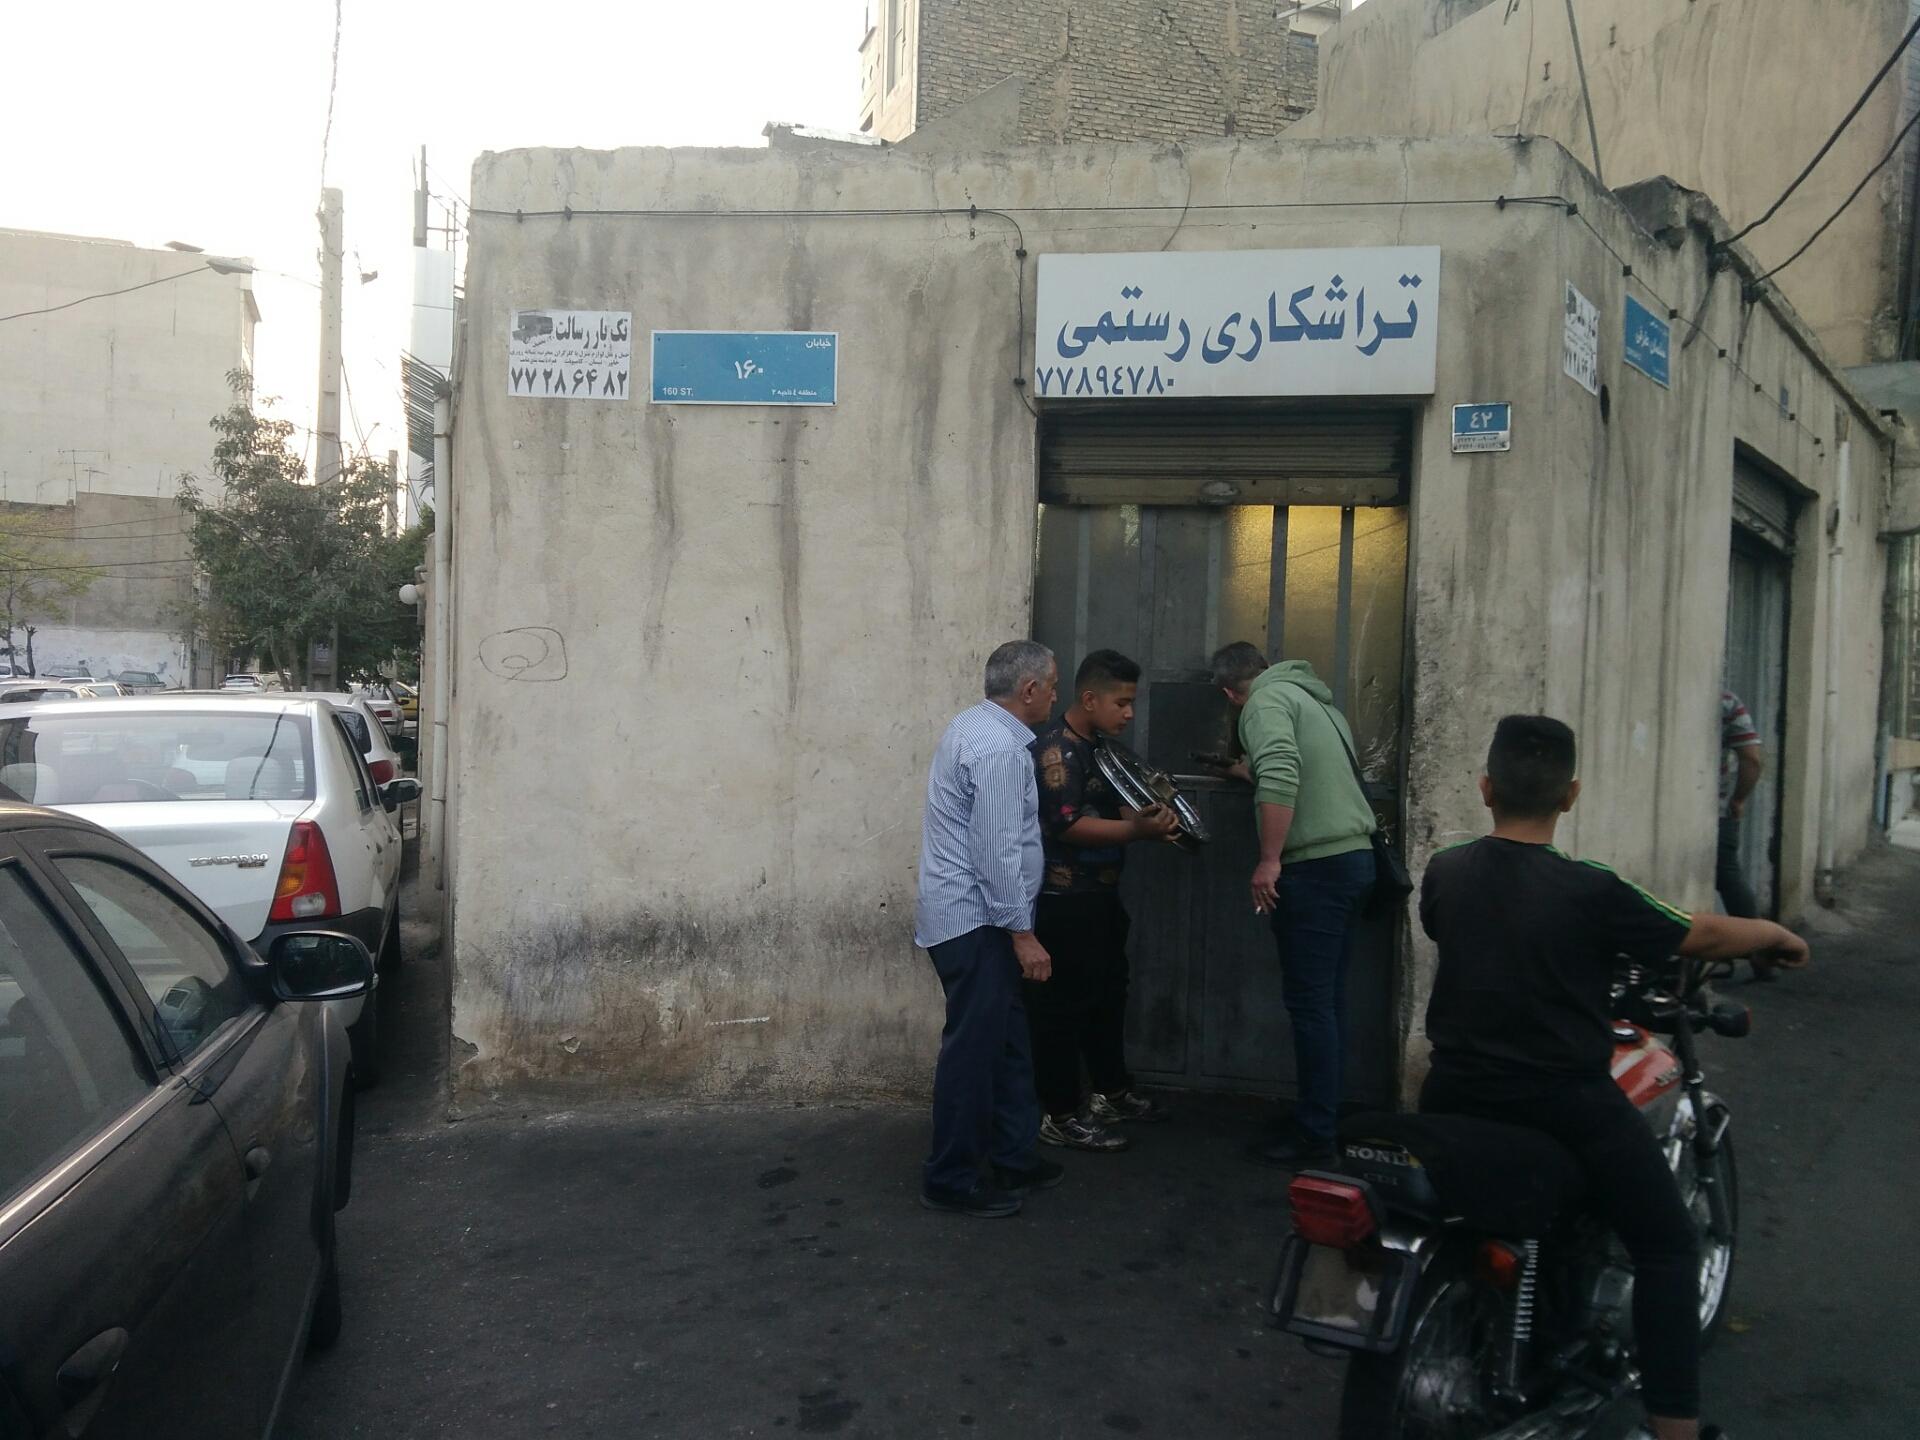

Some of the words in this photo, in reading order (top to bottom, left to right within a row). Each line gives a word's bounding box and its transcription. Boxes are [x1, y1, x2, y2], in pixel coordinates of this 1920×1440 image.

[610, 318, 628, 342] تک
[1056, 285, 1191, 363] رستمی
[1201, 273, 1423, 365] تراشکاری
[555, 314, 590, 349] رسالت
[805, 338, 832, 349] خیابان
[734, 359, 763, 379] ۱۶۰
[662, 387, 678, 396] 160
